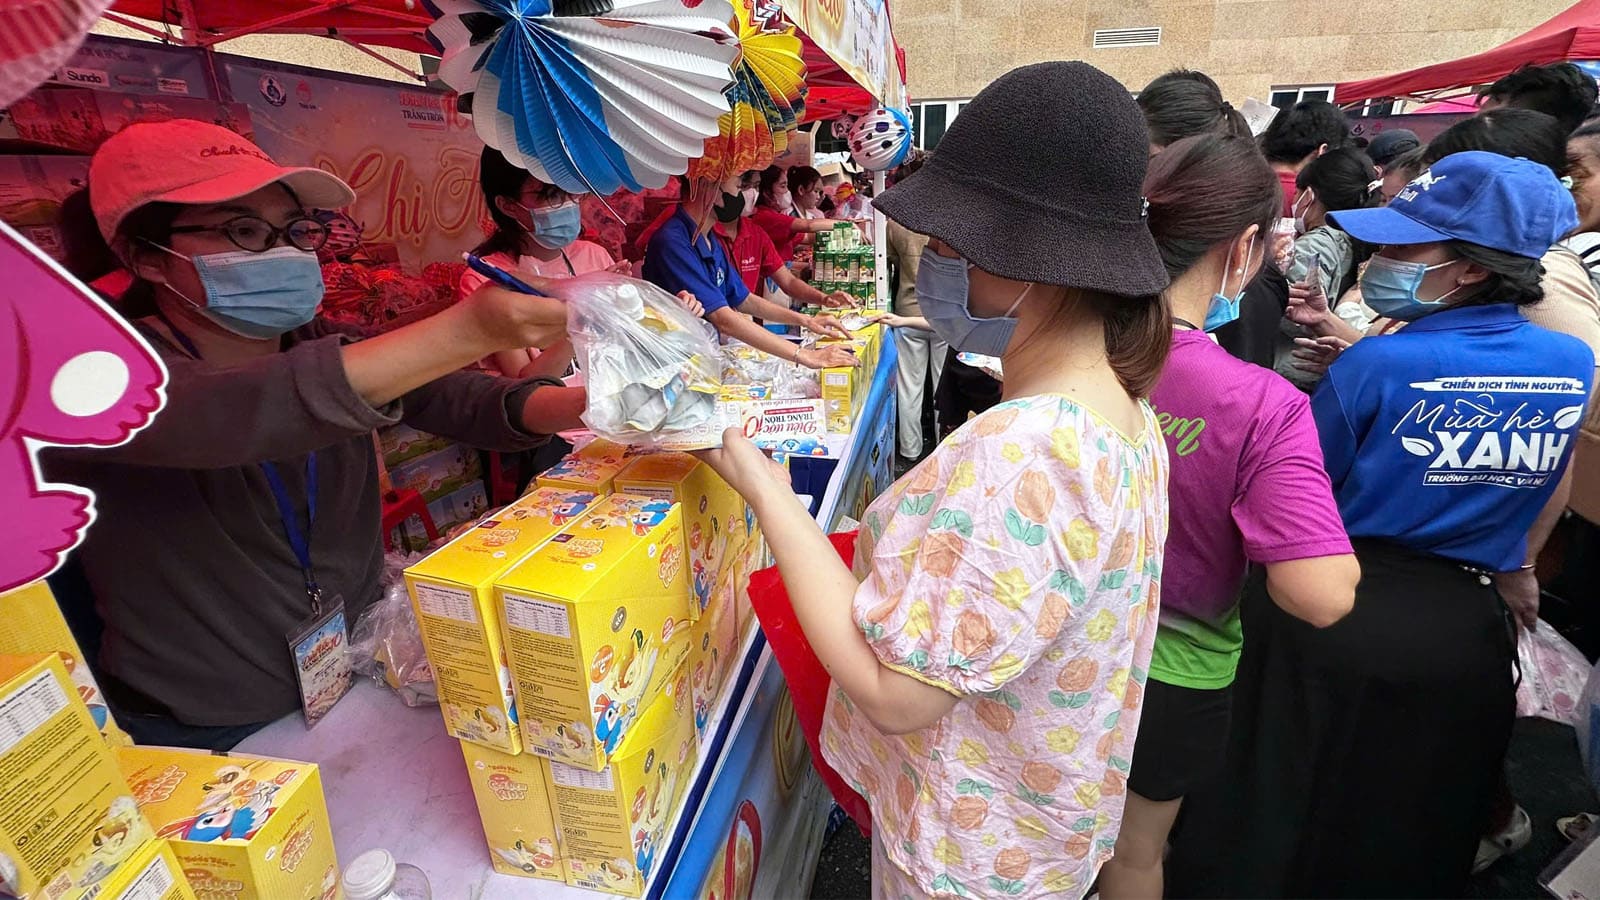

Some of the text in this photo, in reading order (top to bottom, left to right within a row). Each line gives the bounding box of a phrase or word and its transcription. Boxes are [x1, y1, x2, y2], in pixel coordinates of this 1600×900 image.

[1441, 379, 1574, 393] CHIẾN DỊCH TÌNH NGUYỆN
[744, 414, 764, 438] 10
[1391, 399, 1551, 434] Mùa hè
[1428, 431, 1570, 471] XANH
[1427, 473, 1469, 483] TRƯỜNG
